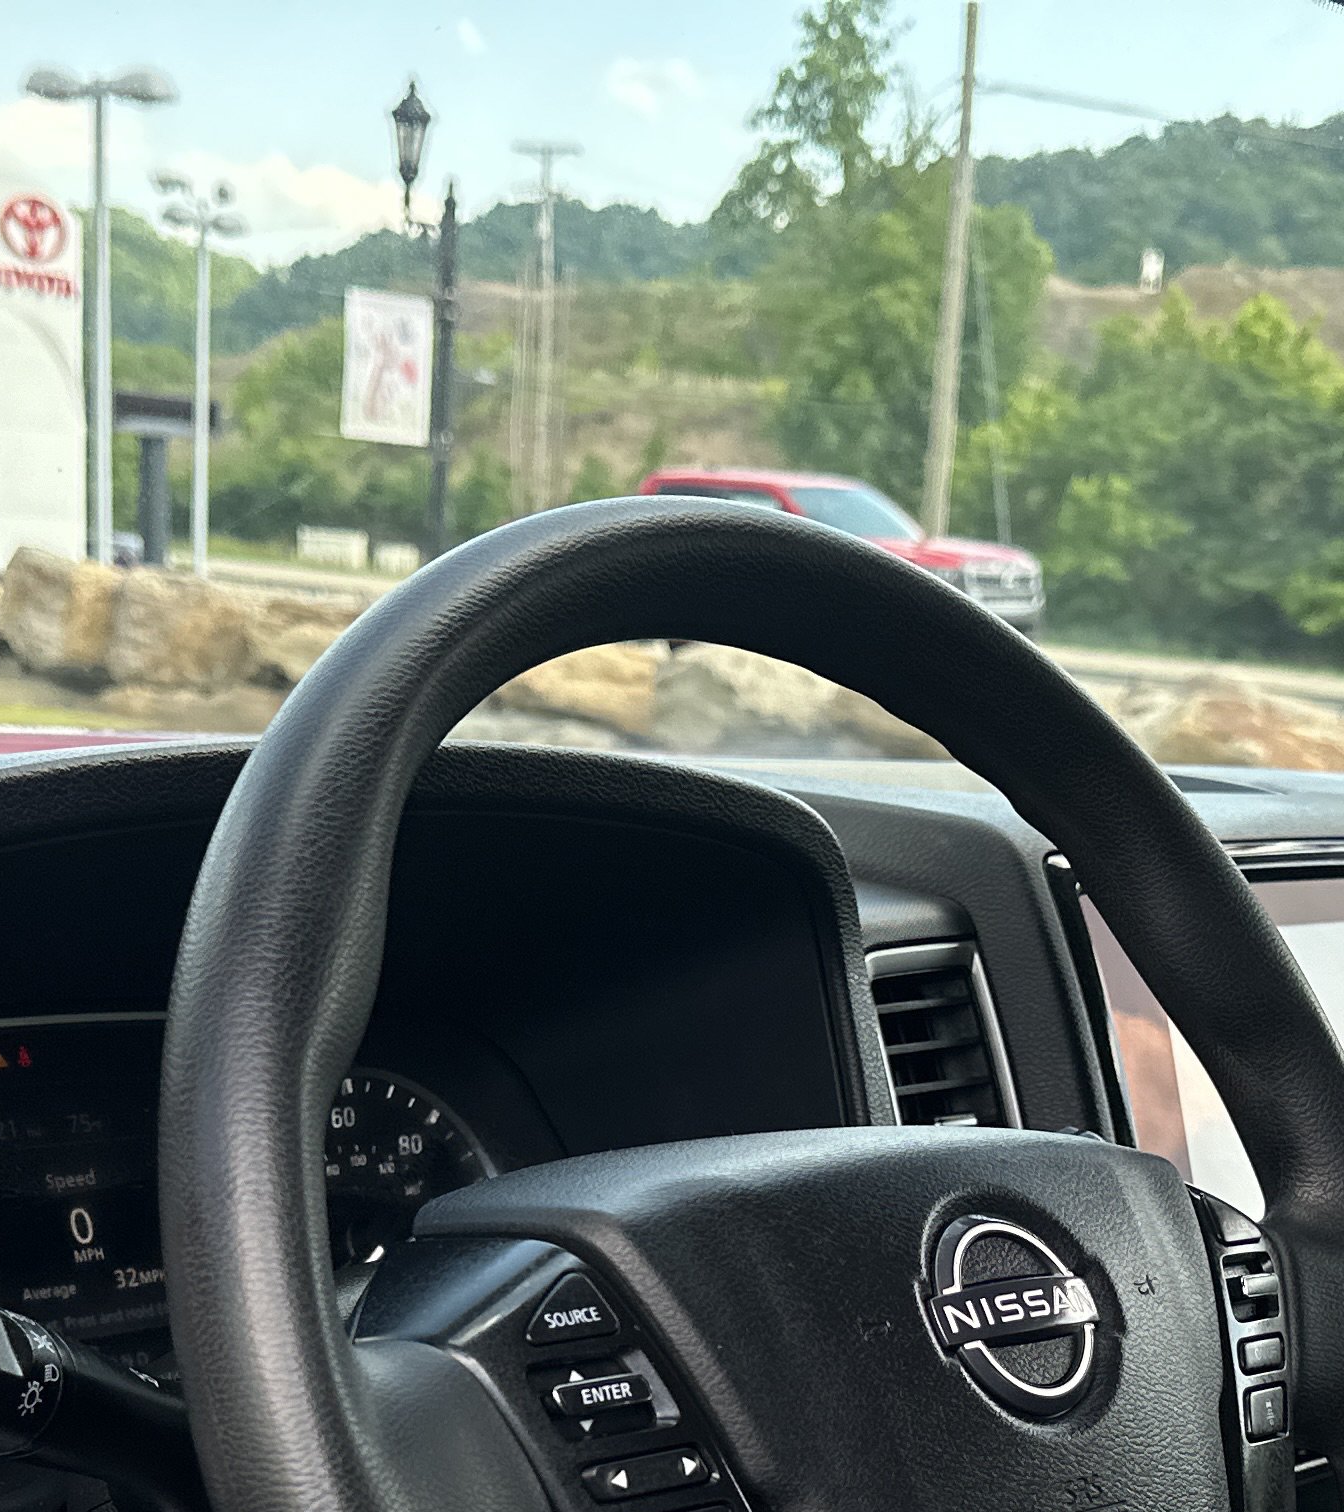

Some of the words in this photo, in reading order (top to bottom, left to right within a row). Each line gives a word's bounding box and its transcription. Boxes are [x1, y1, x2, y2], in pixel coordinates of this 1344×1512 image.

[331, 1106, 356, 1129] 60
[398, 1133, 423, 1156] 80
[46, 1168, 96, 1191] Speed
[70, 1207, 94, 1245] 0
[74, 1248, 106, 1264] MPH
[23, 1282, 77, 1303] Average
[544, 1306, 602, 1330] SOURCE
[942, 1285, 1097, 1335] NISSAN
[581, 1382, 632, 1406] ENTER
